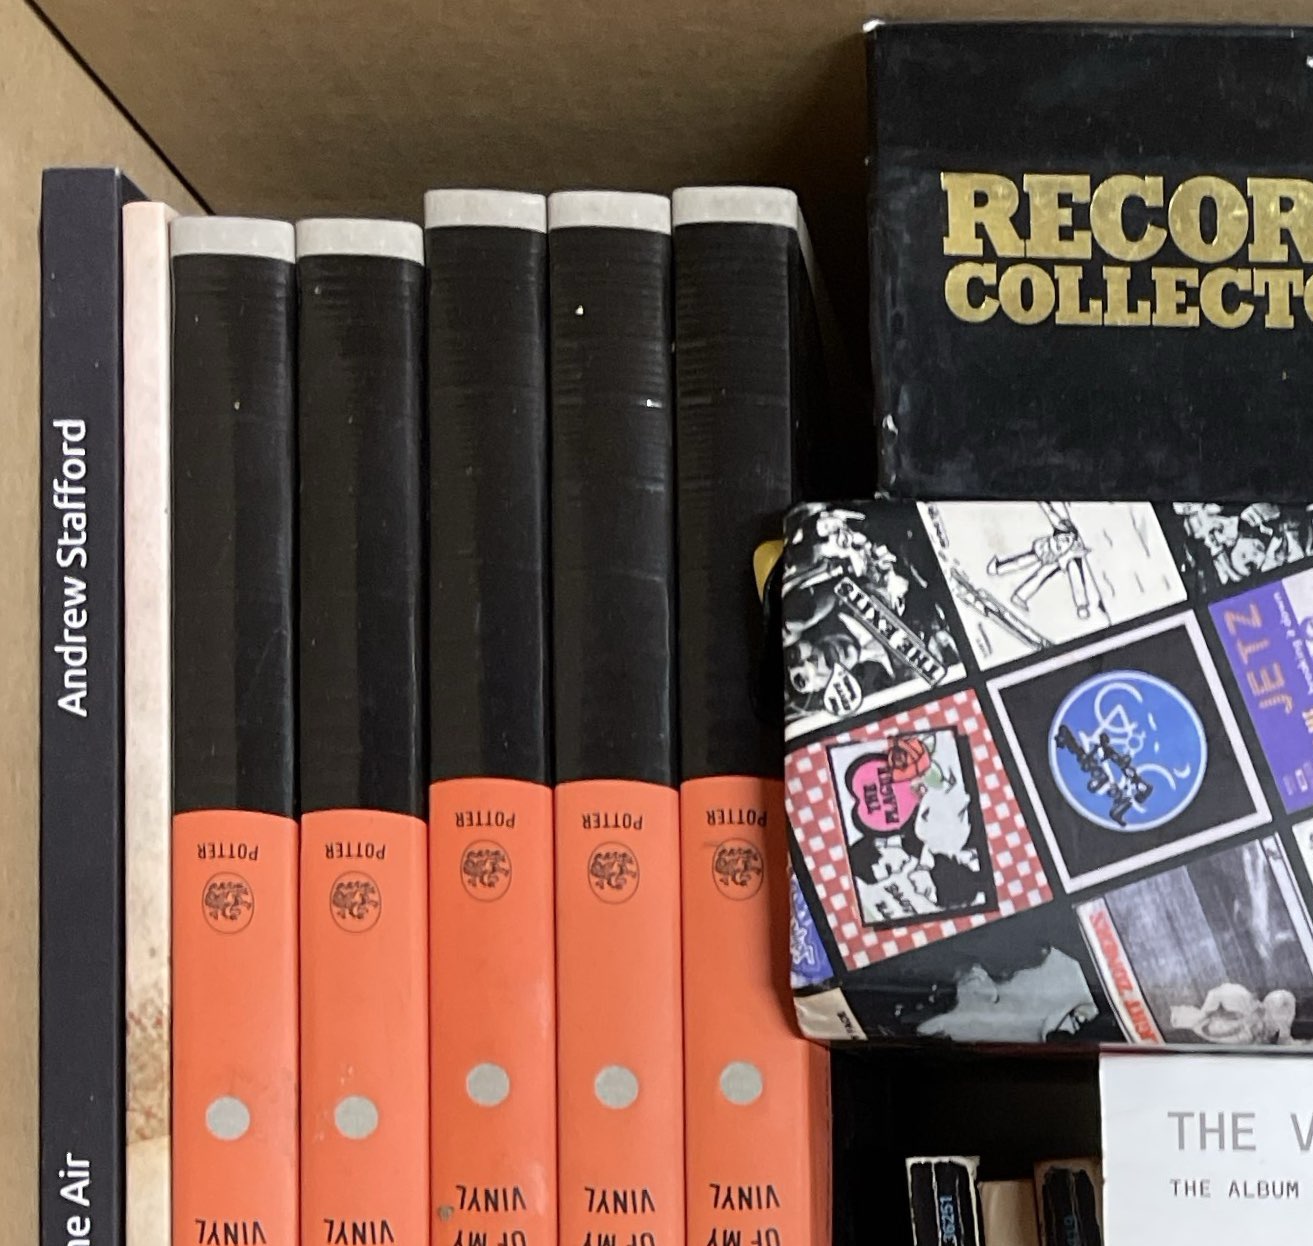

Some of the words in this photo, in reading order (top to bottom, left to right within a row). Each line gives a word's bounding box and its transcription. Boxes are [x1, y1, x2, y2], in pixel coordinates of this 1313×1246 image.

[52, 418, 87, 569] Stafford
[54, 575, 88, 718] Andrew
[1224, 601, 1293, 715] JETZ
[454, 810, 517, 830] POTTER
[581, 811, 645, 831] POTTER
[706, 808, 769, 828] POTTER
[196, 842, 260, 861] POTTER
[324, 842, 388, 861] POTTER
[1168, 1112, 1257, 1151] THE
[58, 1152, 92, 1208] Air
[1170, 1178, 1211, 1199] THE
[1228, 1180, 1299, 1200] ALBUM
[455, 1184, 527, 1212] VINYL
[584, 1185, 656, 1214] VINYL
[709, 1183, 781, 1211] VINYL
[194, 1218, 268, 1246] VINYL
[323, 1218, 395, 1246] VINYL
[939, 1194, 956, 1242] 36251
